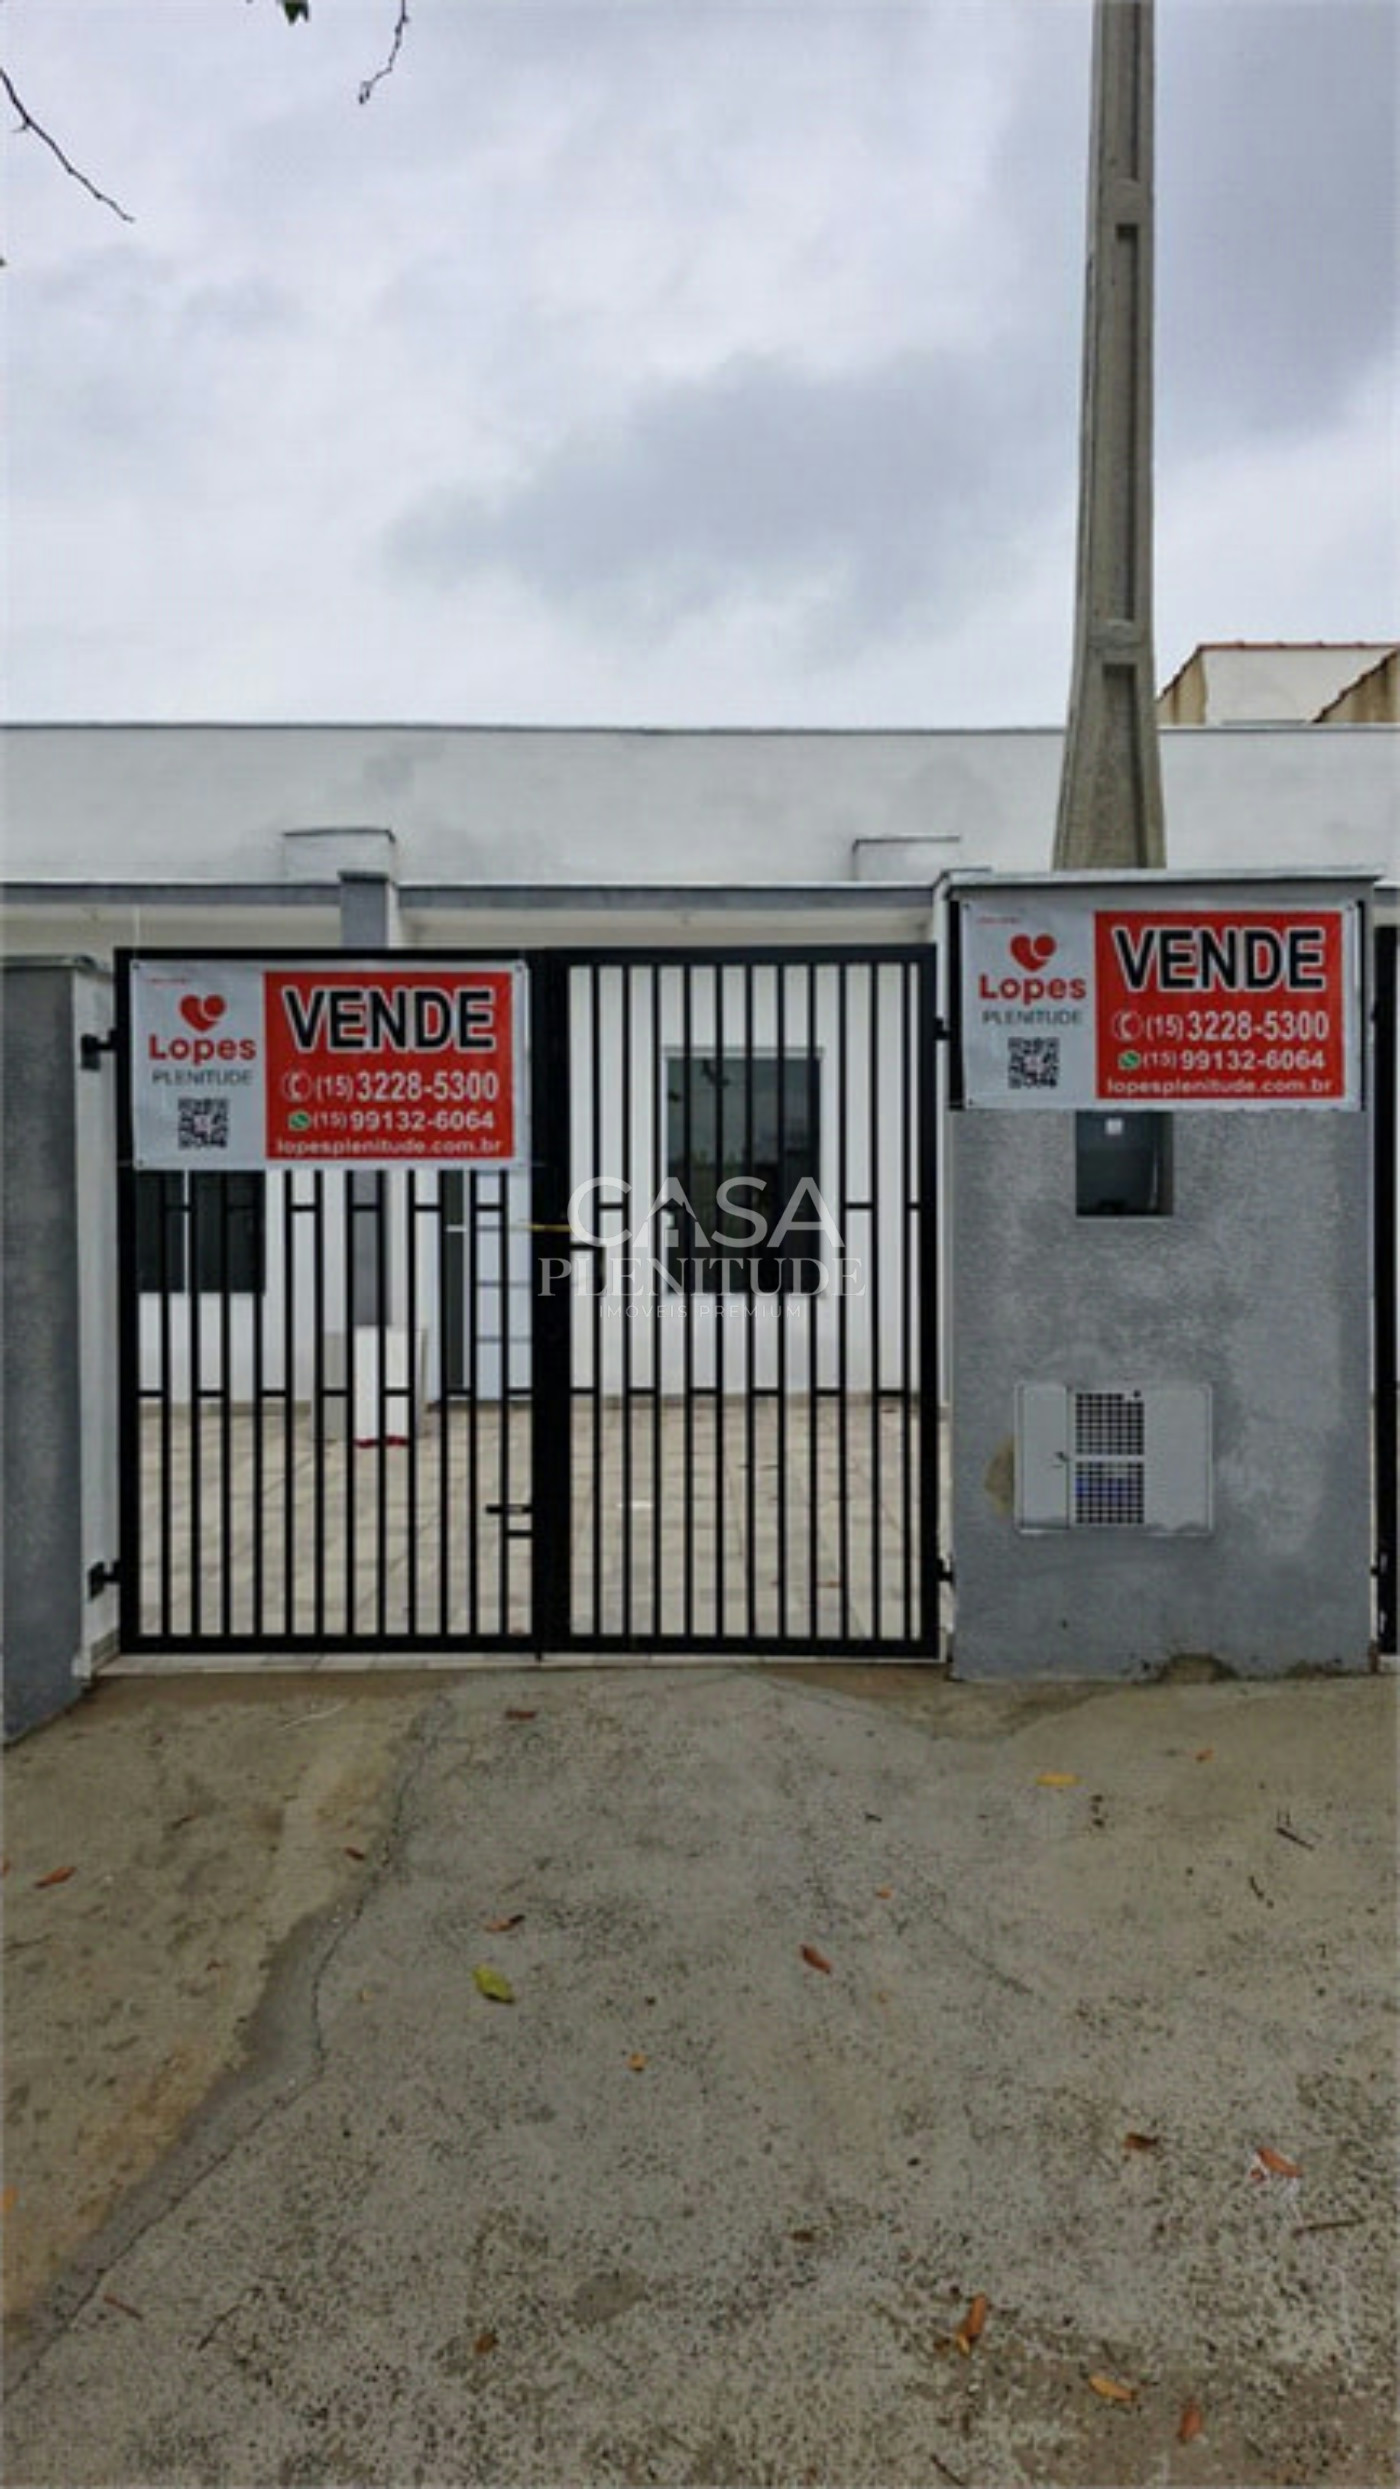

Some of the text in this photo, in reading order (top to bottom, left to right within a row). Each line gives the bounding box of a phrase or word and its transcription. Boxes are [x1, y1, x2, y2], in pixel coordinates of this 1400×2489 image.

[1112, 926, 1325, 993] VENDE
[979, 973, 1086, 1006] Lopes
[282, 985, 496, 1053] VENDE
[982, 1010, 1082, 1026] PLENITUDE
[1186, 1010, 1329, 1041] 3228-5300
[149, 1034, 256, 1066] Lopes
[152, 1069, 253, 1086] PLENITUDE
[356, 1070, 499, 1101] 3228-5300
[1107, 1077, 1332, 1095] lopesplenitude.com.br
[277, 1137, 502, 1156] lopesplenitude.com.br
